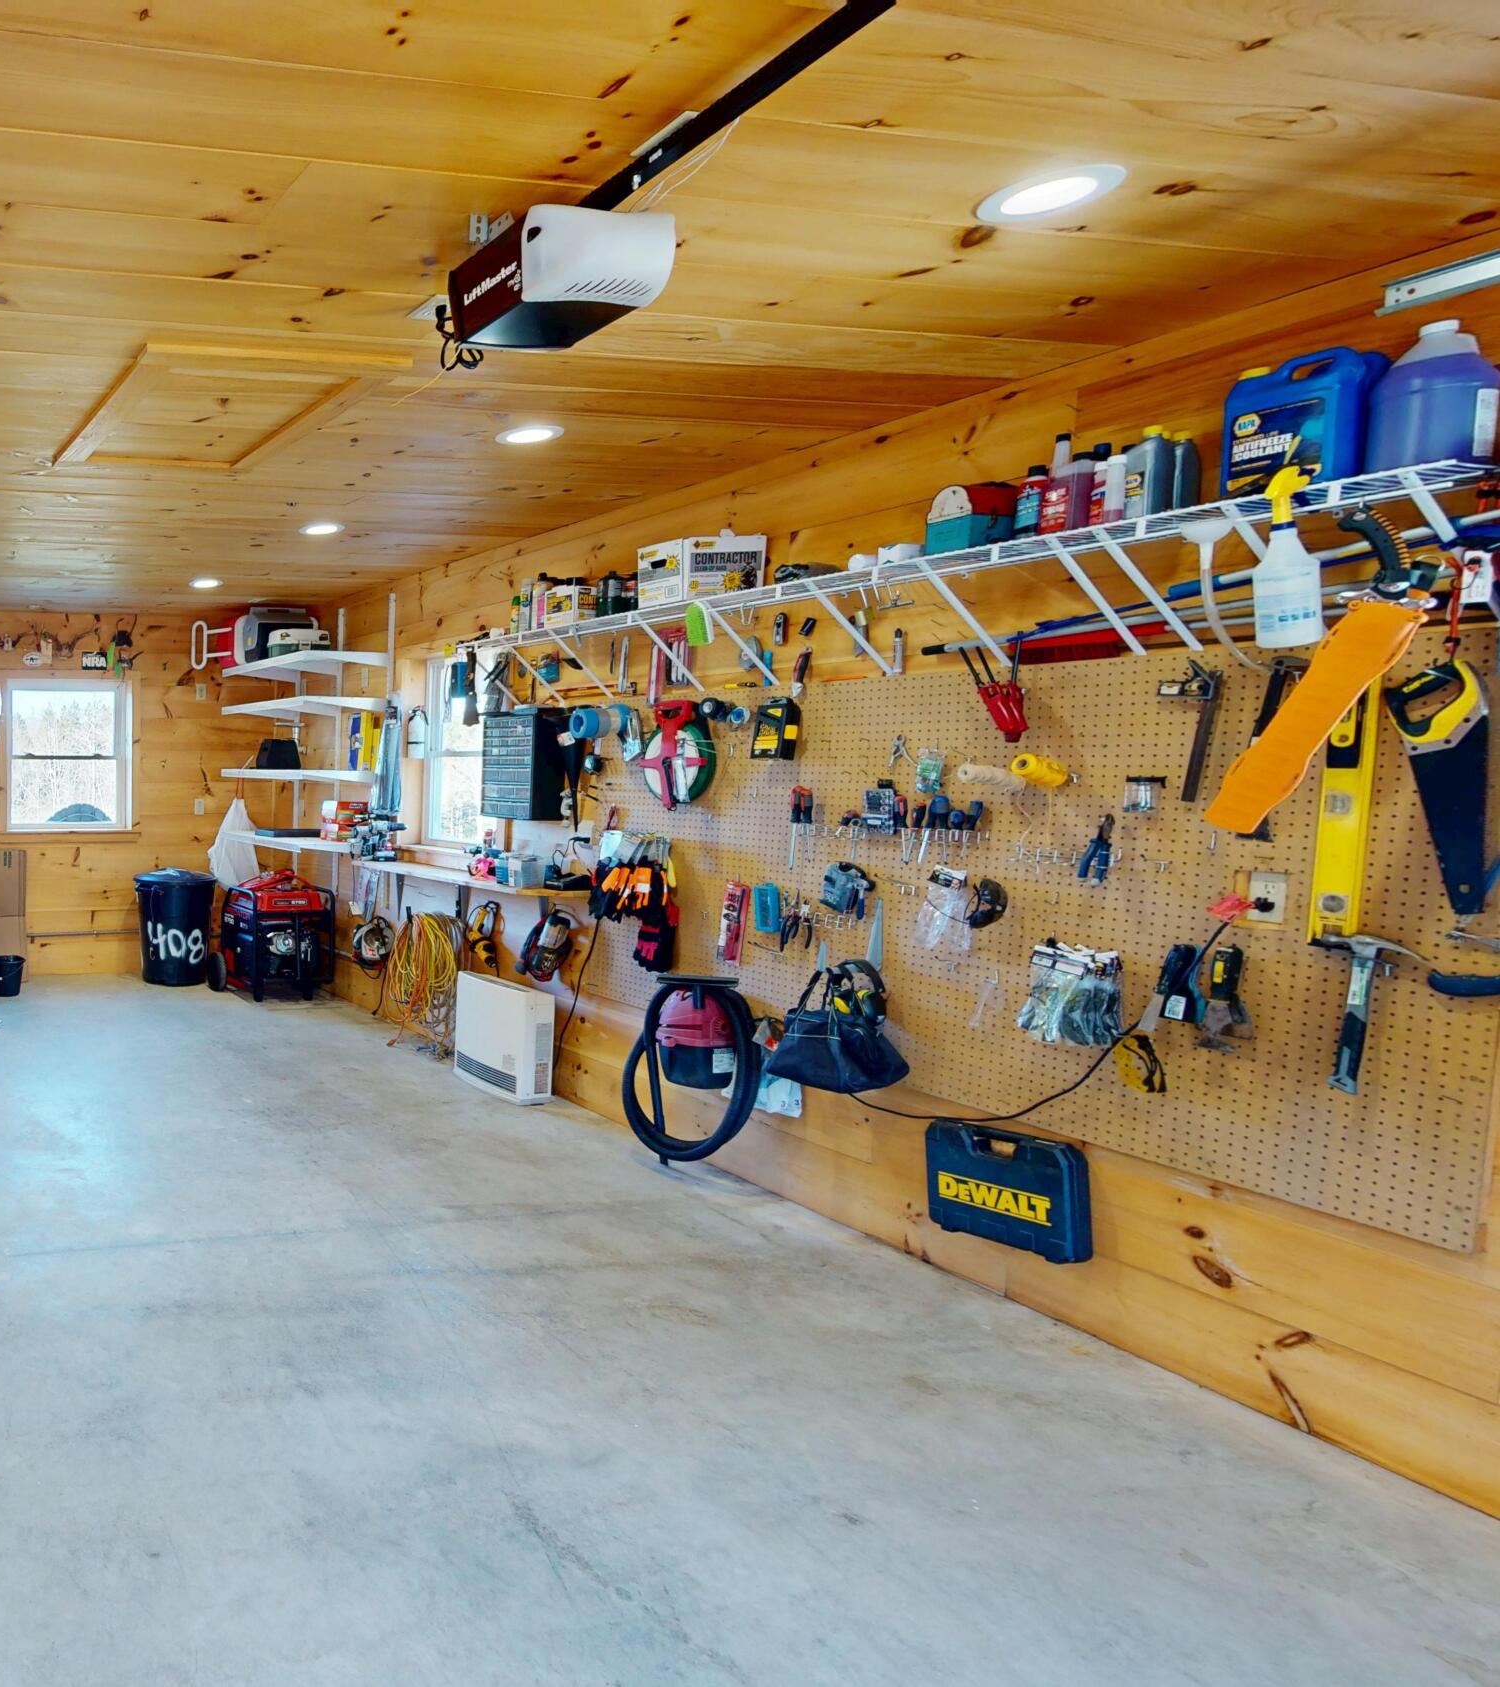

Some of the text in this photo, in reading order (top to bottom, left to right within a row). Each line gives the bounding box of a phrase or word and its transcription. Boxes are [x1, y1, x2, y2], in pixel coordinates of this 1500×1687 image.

[463, 261, 518, 306] LiftMaster
[1238, 419, 1257, 431] NAPA
[1232, 432, 1294, 454] ANTIFREEZE
[1235, 442, 1292, 462] COOLANT
[694, 551, 758, 566] CONTRACTOR
[82, 656, 107, 668] NRA
[147, 920, 206, 964] 408
